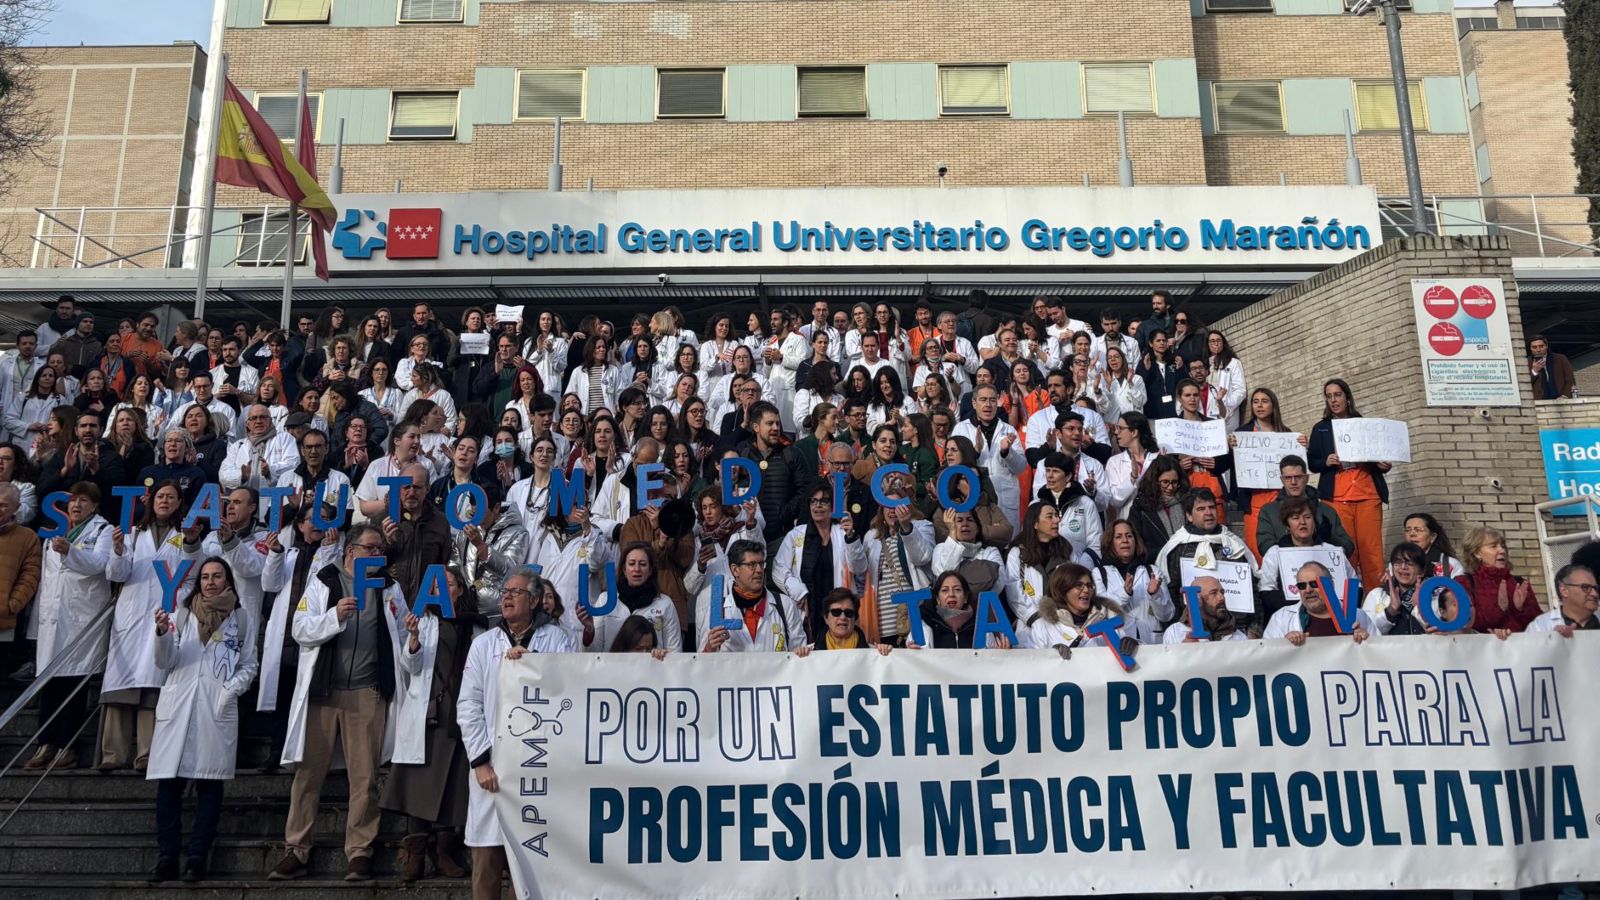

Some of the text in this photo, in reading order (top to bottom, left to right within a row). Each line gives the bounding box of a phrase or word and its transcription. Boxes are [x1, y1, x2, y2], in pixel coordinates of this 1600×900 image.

[454, 215, 1370, 260] Hospital General Universitario Gregorio Marañón
[1552, 441, 1600, 462] Rad
[152, 559, 196, 613] Y
[585, 666, 1566, 765] POR UN ESTATUTO PROPIO PARA LA
[588, 759, 1590, 865] PROFESIÓN MÉDICA Y FACULTATIVA
